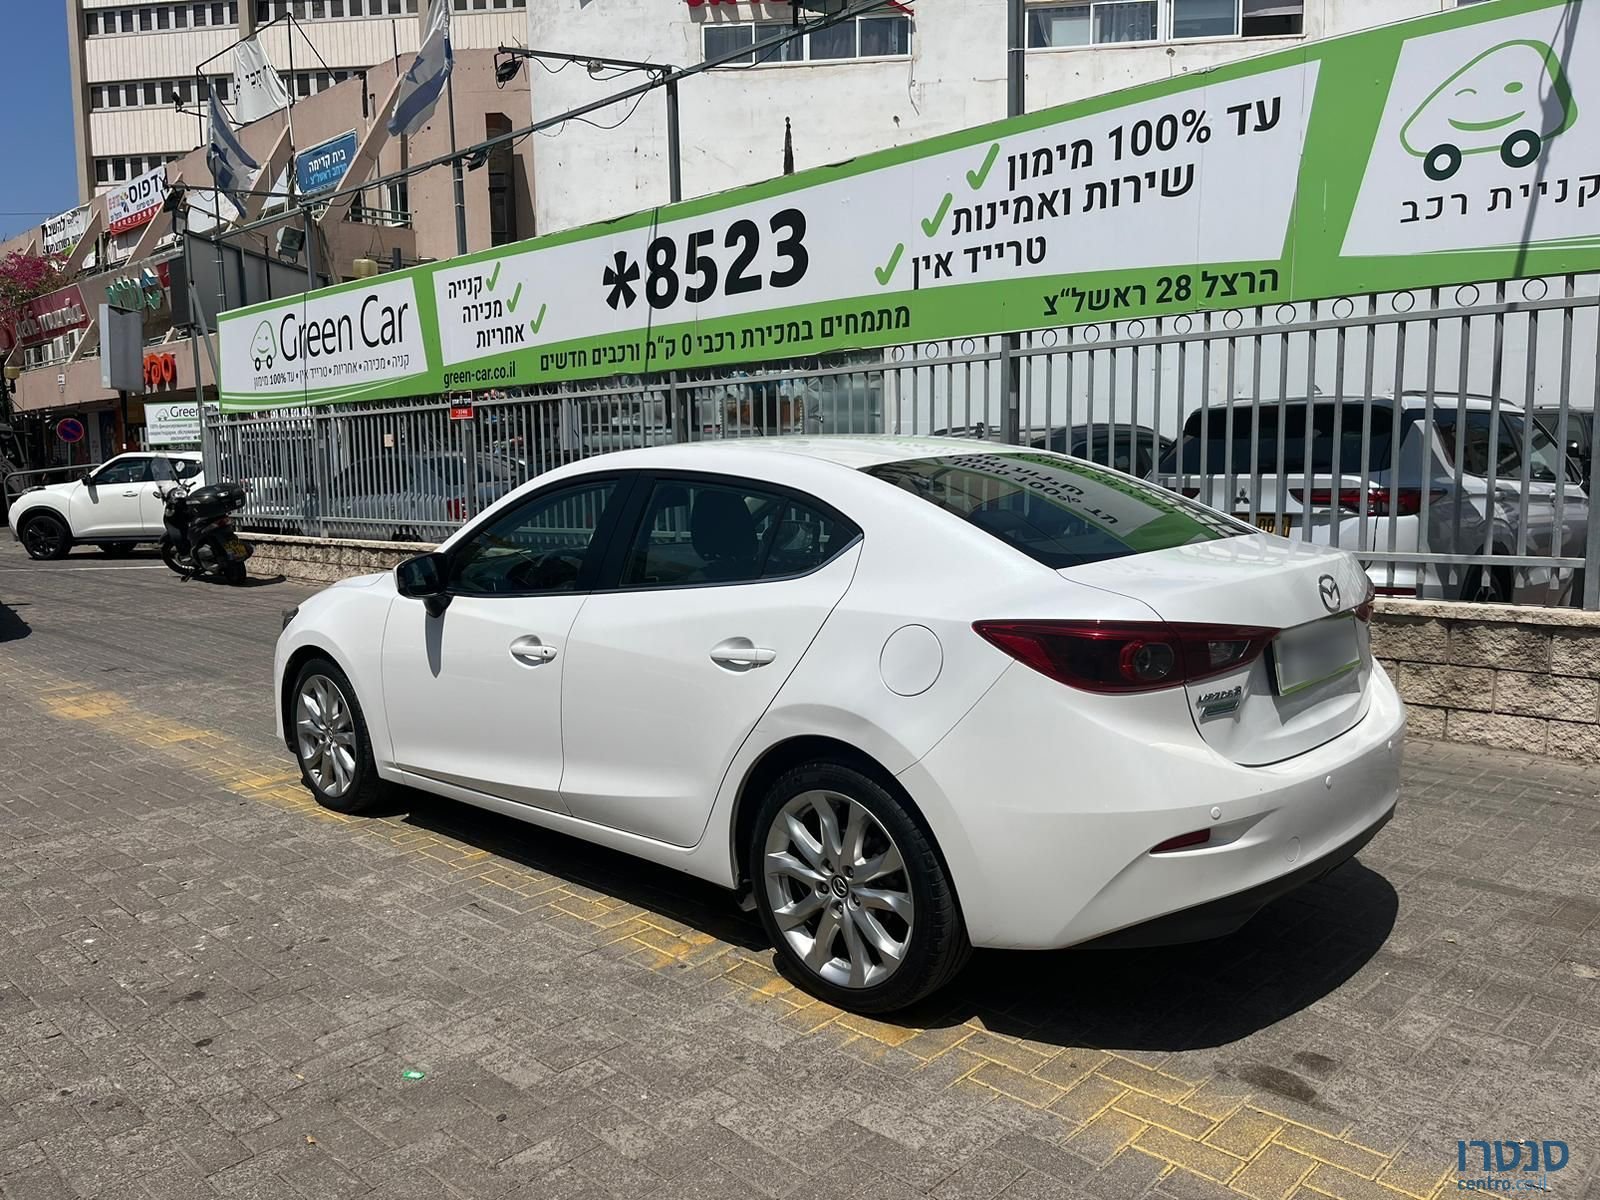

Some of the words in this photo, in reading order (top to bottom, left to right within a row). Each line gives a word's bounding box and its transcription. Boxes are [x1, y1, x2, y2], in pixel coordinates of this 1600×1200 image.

[1227, 97, 1280, 135] עד
[1109, 109, 1211, 160] 100%
[332, 149, 346, 163] בית
[1008, 138, 1093, 191] מימון
[129, 174, 158, 204] דפוס
[1082, 163, 1195, 213] שירות
[1487, 173, 1600, 212] קניית
[952, 188, 1071, 236] ואמינות
[1400, 194, 1468, 223] רכב
[964, 236, 1047, 273] טרייד
[912, 250, 953, 290] אין
[1201, 269, 1279, 299] הרצל
[448, 275, 483, 300] קנייה
[1156, 274, 1192, 303] 28
[462, 299, 503, 324] מכירה
[820, 306, 910, 338] מתמחים
[280, 314, 353, 362] Green
[360, 295, 408, 347] Car
[477, 323, 525, 349] אחריות
[697, 331, 735, 354] רכבי
[740, 320, 814, 349] במכירת
[541, 350, 587, 372] חדשים
[593, 342, 640, 366] ורכבים
[270, 372, 286, 385] 100%
[444, 361, 516, 389] green-car.co.il
